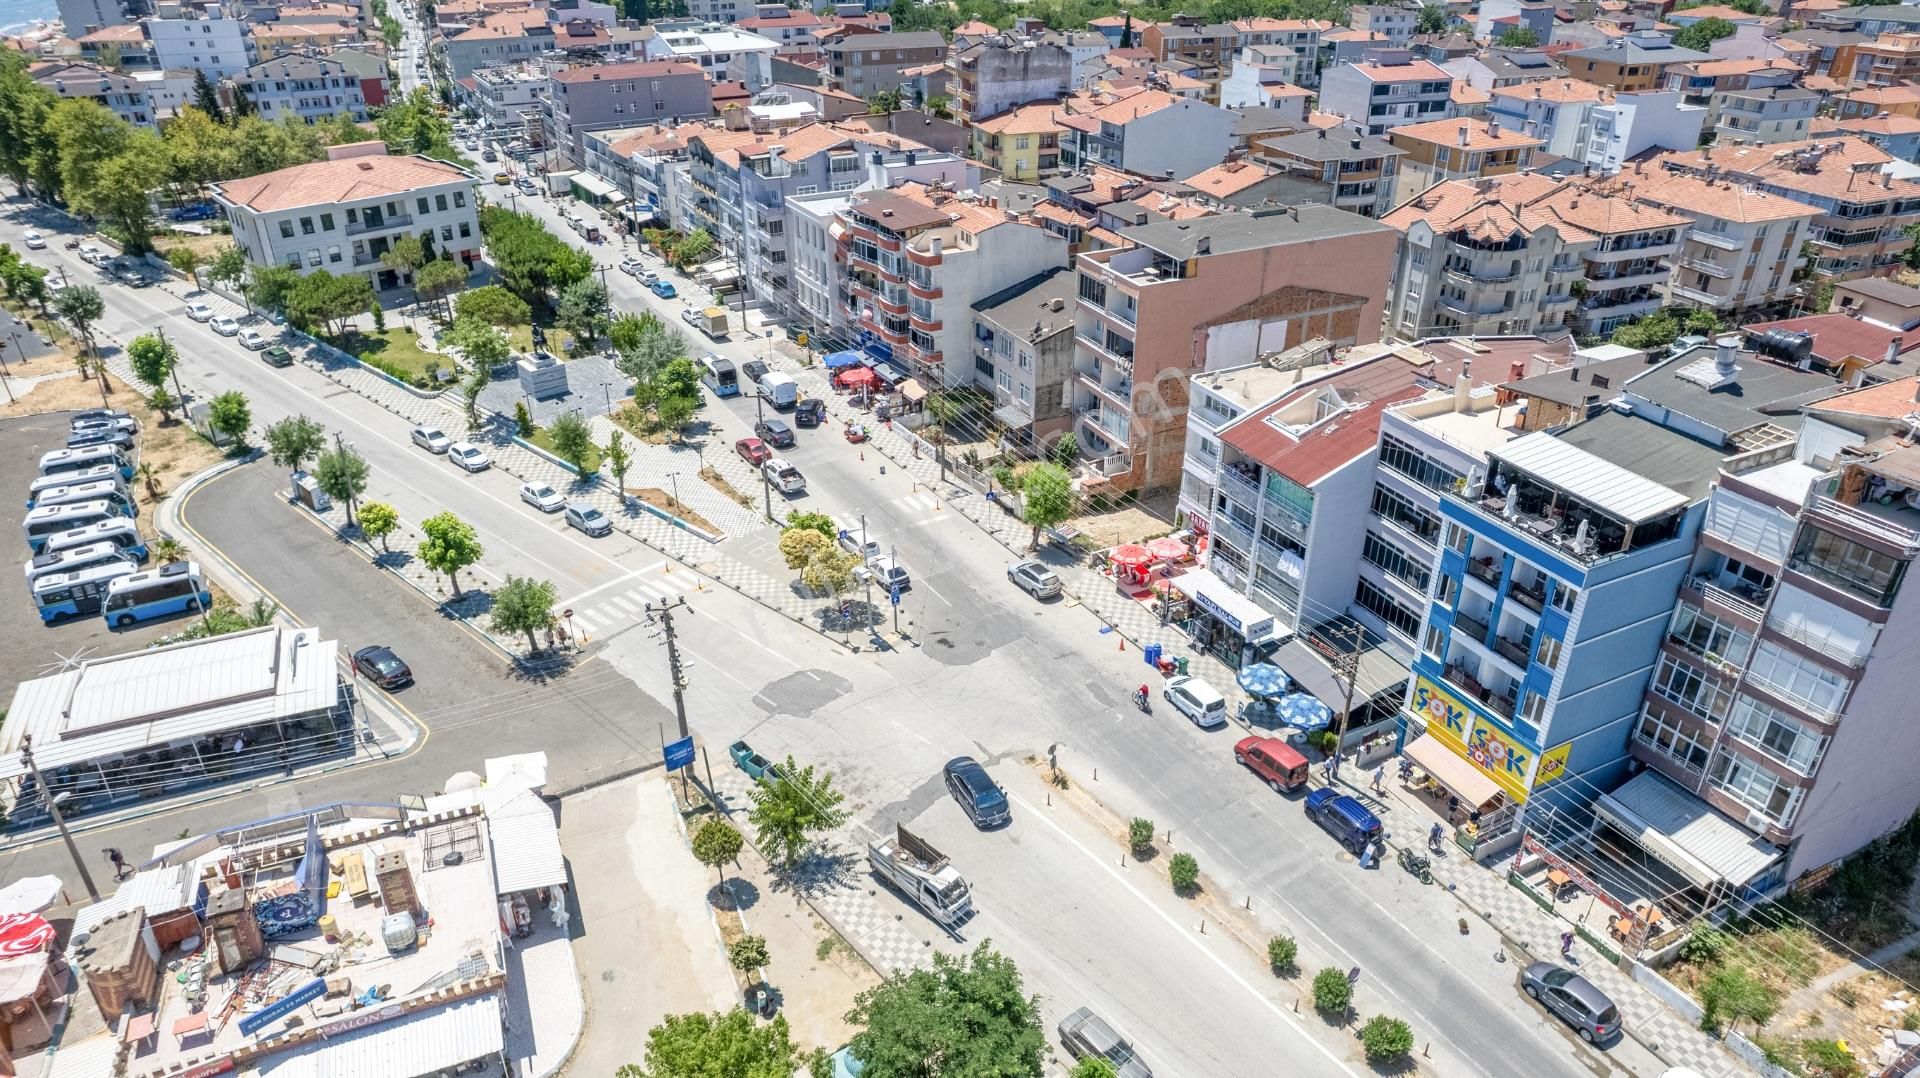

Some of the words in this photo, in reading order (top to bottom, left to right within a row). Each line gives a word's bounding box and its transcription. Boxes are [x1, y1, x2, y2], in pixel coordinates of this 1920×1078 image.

[1416, 687, 1463, 733] ŞOK
[1475, 728, 1526, 777] ŞOK
[262, 1005, 286, 1022] DURAK
[295, 986, 322, 1005] MARKET
[331, 1012, 380, 1034] SALON
